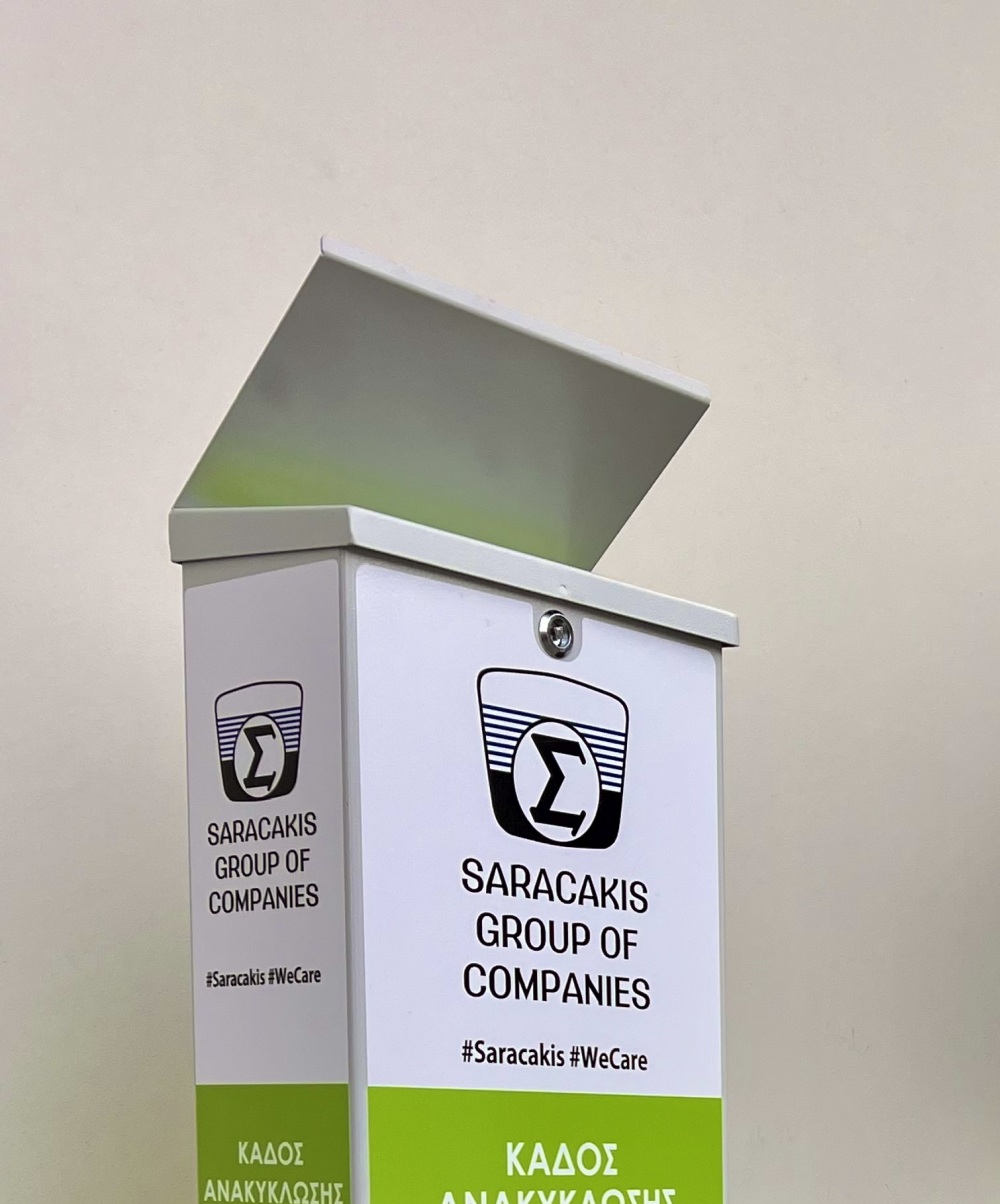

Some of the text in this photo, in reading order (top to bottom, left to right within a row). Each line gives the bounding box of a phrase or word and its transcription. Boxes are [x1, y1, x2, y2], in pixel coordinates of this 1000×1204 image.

[207, 811, 317, 846] SARACAKIS
[215, 848, 310, 880] GROUP OF
[209, 883, 319, 914] COMPANIES
[461, 858, 648, 913] SARACAKIS
[475, 913, 638, 960] GROUP OF
[206, 966, 321, 988] #Saracakis #WeCare
[463, 963, 651, 1010] COMPANIES
[461, 1039, 648, 1071] #Saracakis #WeCare
[238, 1141, 304, 1166] ΚΑΔΟΣ
[506, 1142, 618, 1176] ΚΑΔΟΣ
